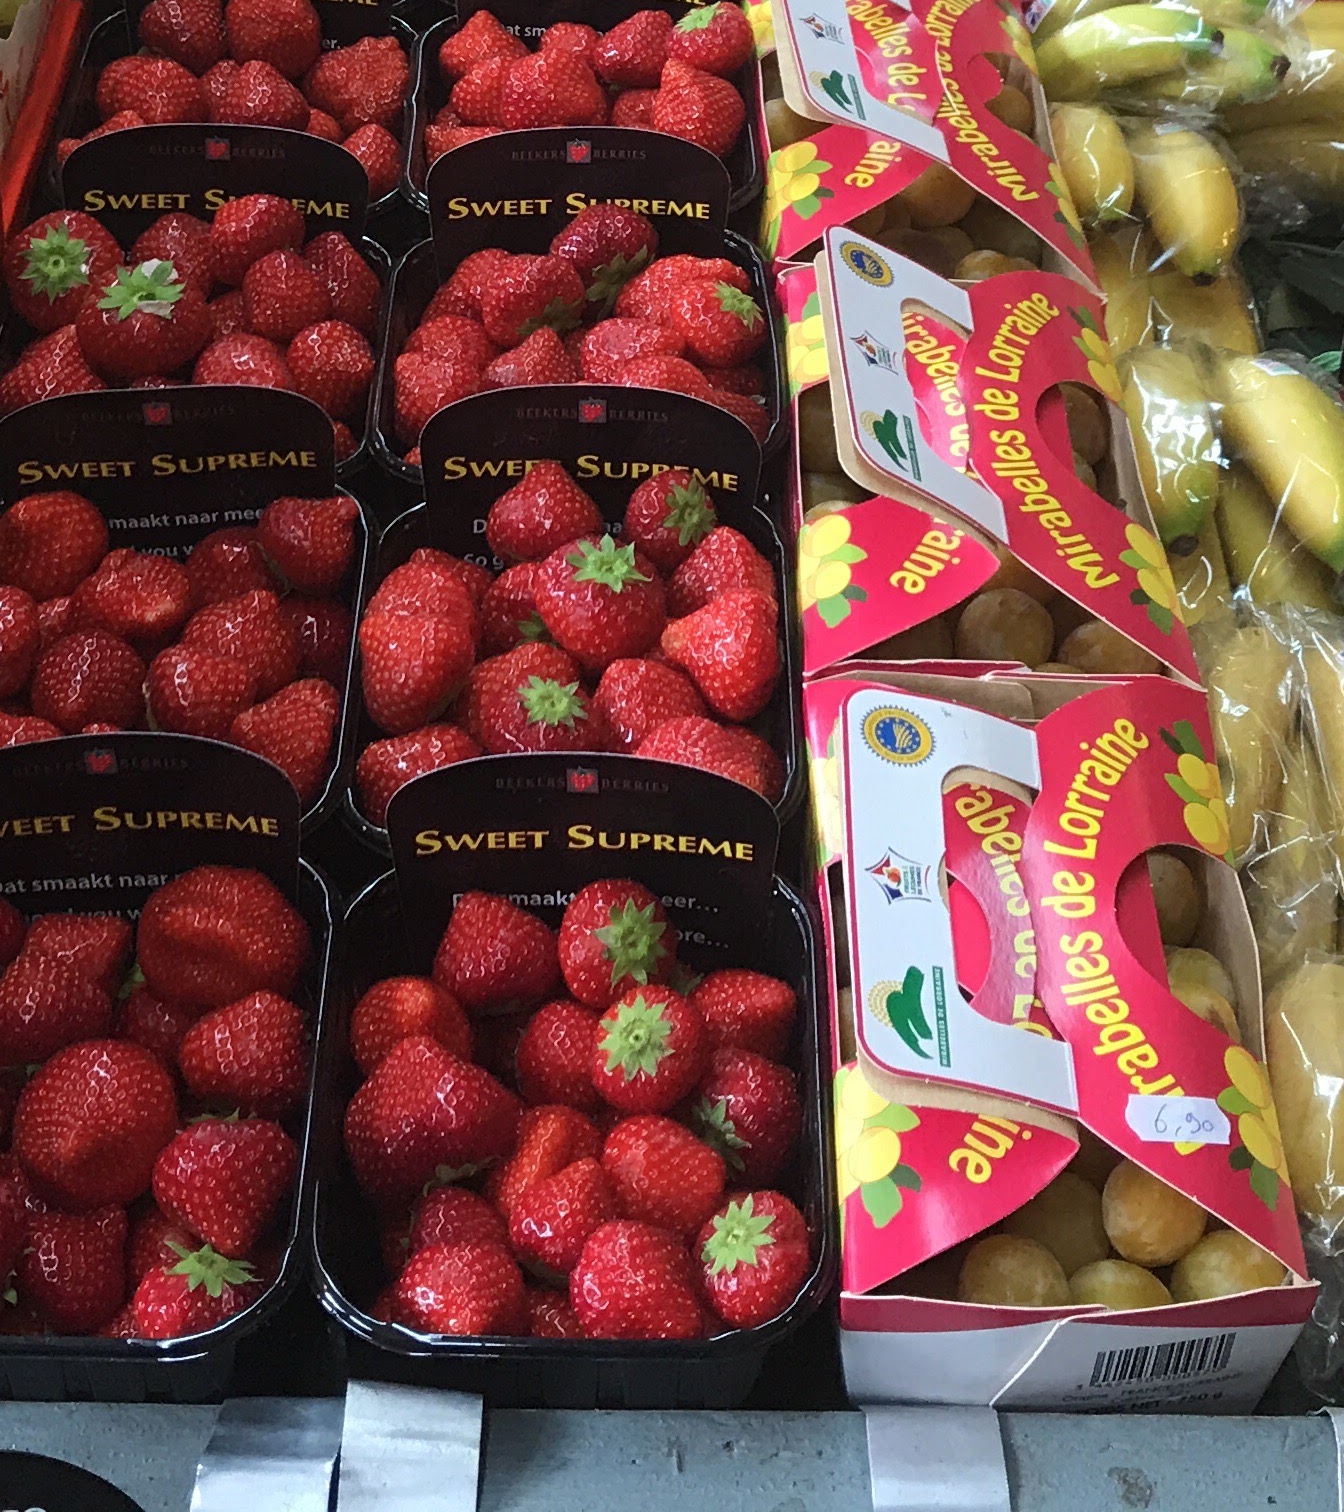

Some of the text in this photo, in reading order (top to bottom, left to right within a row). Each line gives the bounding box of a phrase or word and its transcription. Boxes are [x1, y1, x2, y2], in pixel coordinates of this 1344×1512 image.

[888, 63, 928, 87] de
[84, 190, 190, 213] SWEET
[448, 195, 553, 220] SWEET
[974, 293, 1121, 589] Mirabelles de Lorraine
[17, 450, 319, 486] SWEET SUPREME
[109, 509, 220, 530] maakt naar
[93, 806, 281, 838] SUPREME
[1040, 717, 1150, 919] de Lorraine
[415, 824, 754, 862] SWEET SUPREME
[32, 873, 115, 893] smaakt
[119, 871, 169, 889] naar
[511, 891, 720, 915] maakt eer...
